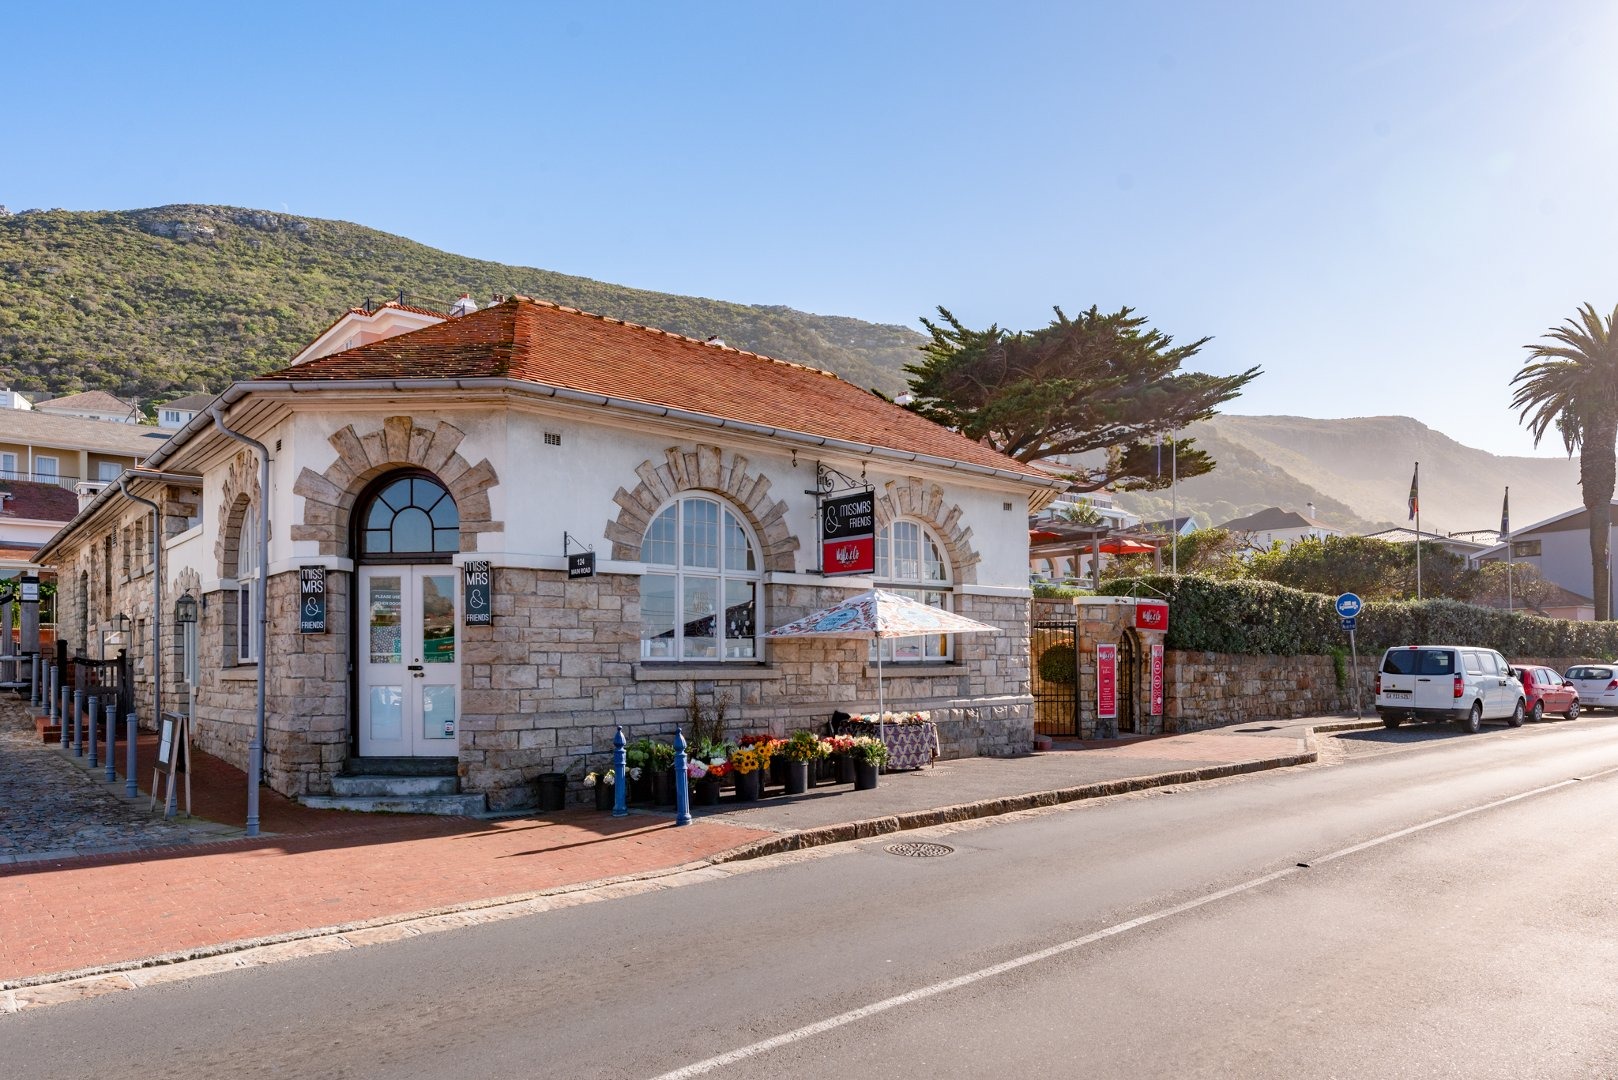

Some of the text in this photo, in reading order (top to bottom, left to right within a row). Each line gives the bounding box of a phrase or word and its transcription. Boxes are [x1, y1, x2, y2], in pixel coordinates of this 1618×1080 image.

[849, 516, 871, 528] FRIENDS
[466, 572, 488, 586] MRS
[302, 580, 324, 593] MRS
[470, 589, 486, 608] &
[305, 597, 321, 616] &
[466, 613, 489, 622] FRIENDS
[301, 621, 324, 629] FRIENDS
